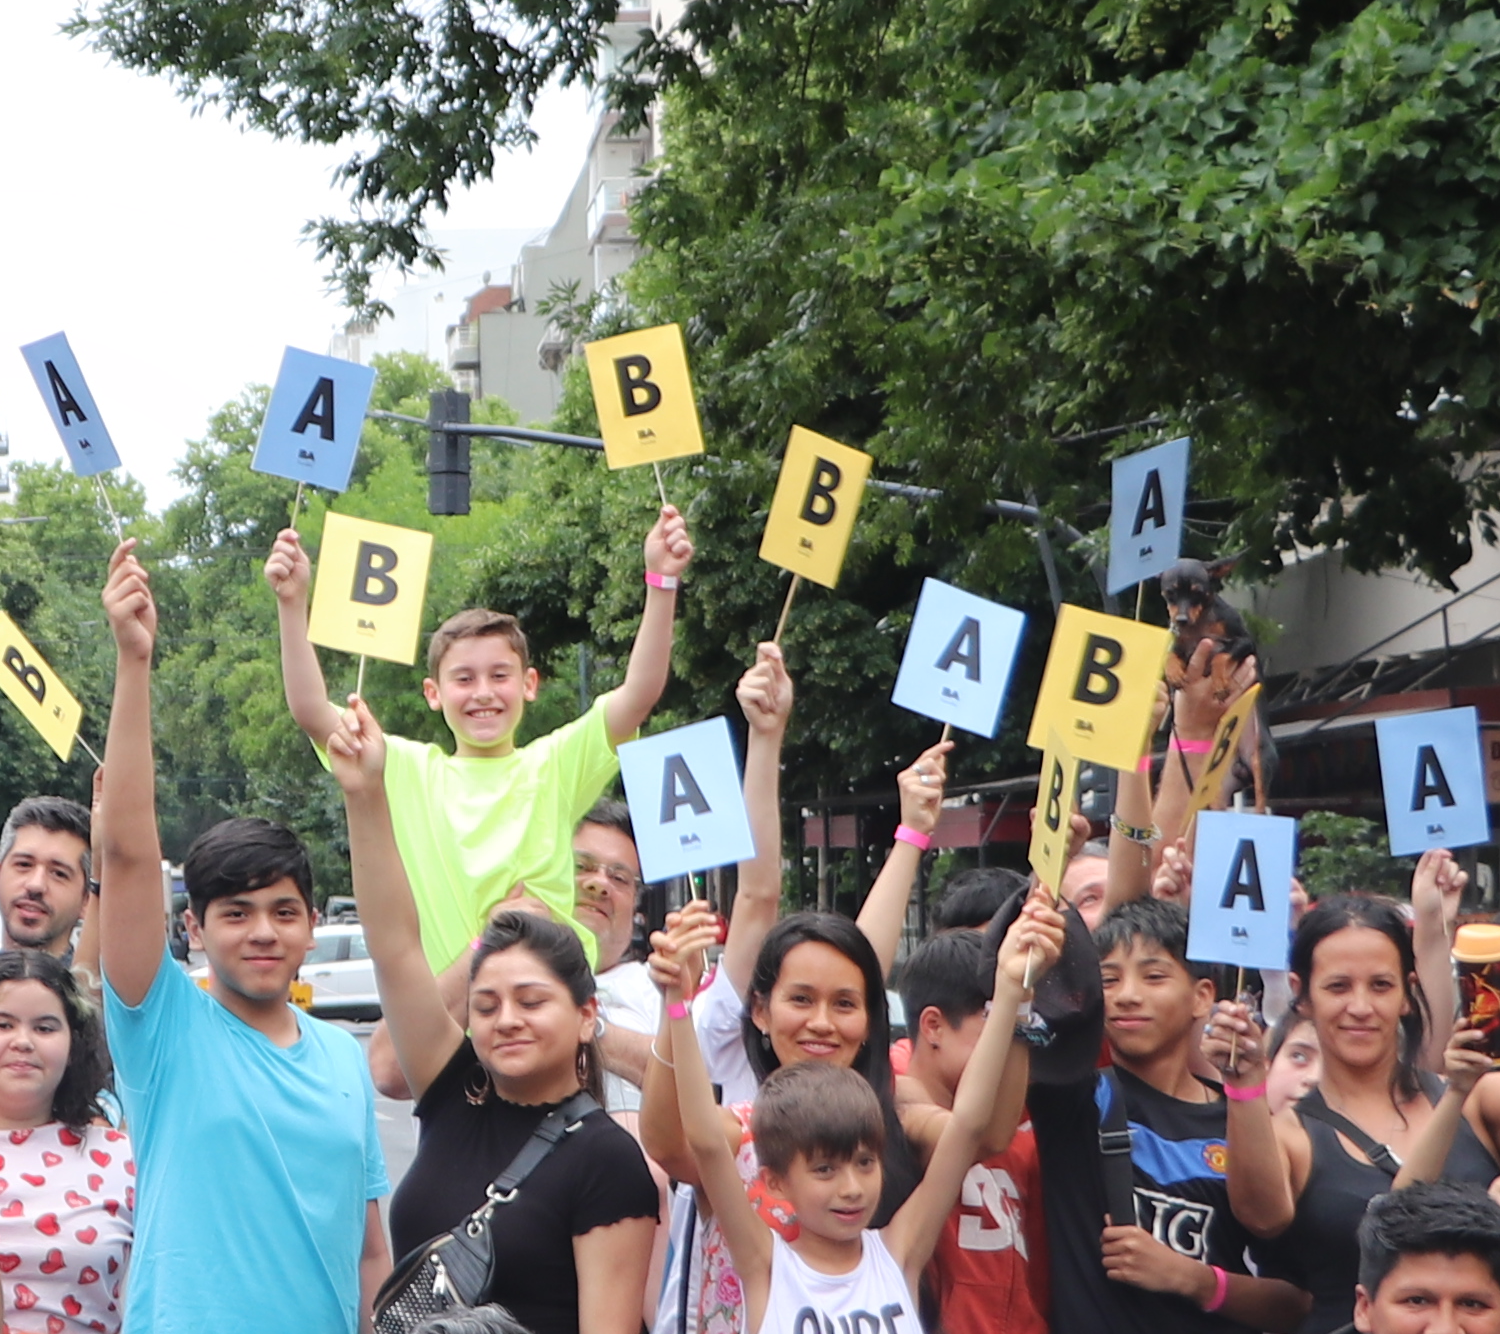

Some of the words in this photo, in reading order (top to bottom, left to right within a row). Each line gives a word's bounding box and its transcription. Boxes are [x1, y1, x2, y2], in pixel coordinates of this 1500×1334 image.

[44, 359, 88, 427] A
[291, 376, 335, 442] A
[614, 354, 662, 418] B
[799, 456, 842, 527] B
[1131, 468, 1167, 537] A
[350, 540, 399, 606] B
[2, 645, 47, 706] B
[935, 616, 981, 683] A
[1071, 633, 1124, 706] B
[1207, 715, 1239, 774] B
[1411, 744, 1456, 812] A
[659, 753, 712, 824] A
[1045, 758, 1064, 833] B
[1220, 839, 1266, 912] A
